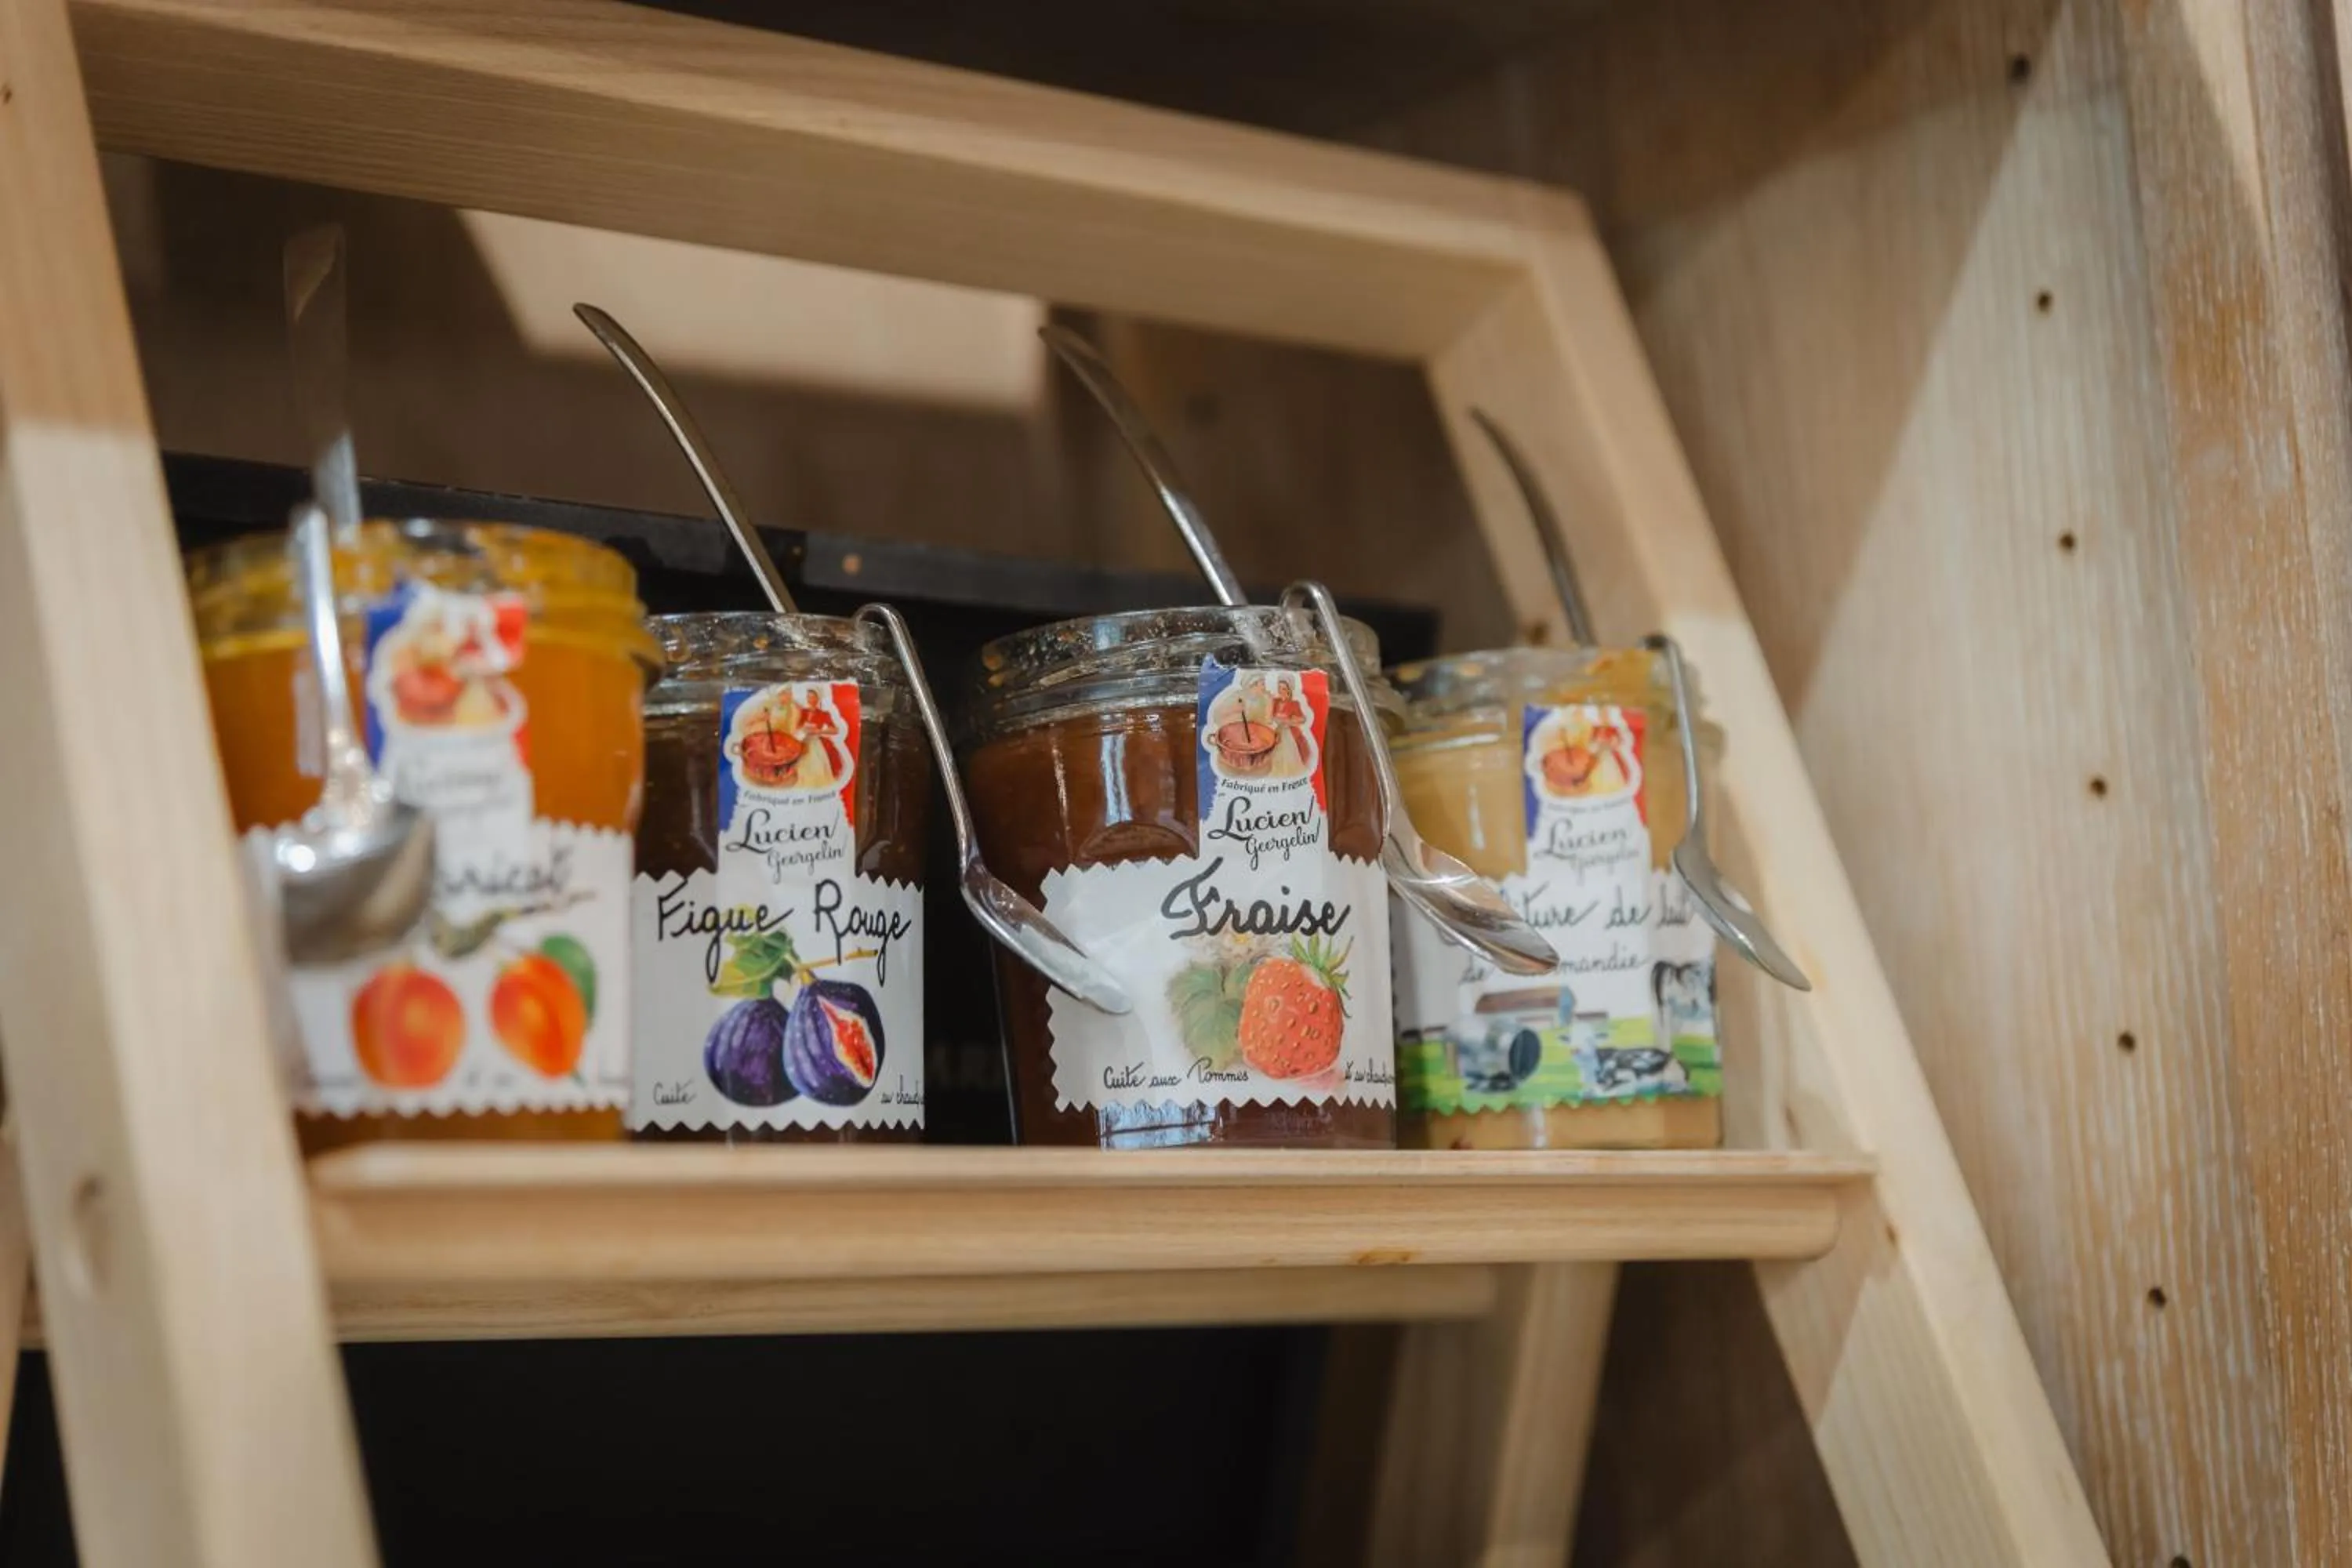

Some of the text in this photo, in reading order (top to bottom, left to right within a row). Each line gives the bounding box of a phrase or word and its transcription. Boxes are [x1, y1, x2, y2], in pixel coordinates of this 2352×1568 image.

[725, 808, 840, 855] Lucien
[1207, 794, 1315, 841] Lucien
[1245, 816, 1321, 872] Georgelin
[1160, 856, 1351, 940] Fraise
[657, 878, 913, 988] Figue Rouge
[1103, 1061, 1146, 1089] Cuite
[1148, 1076, 1182, 1089] aux
[1187, 1056, 1250, 1083] Pommes
